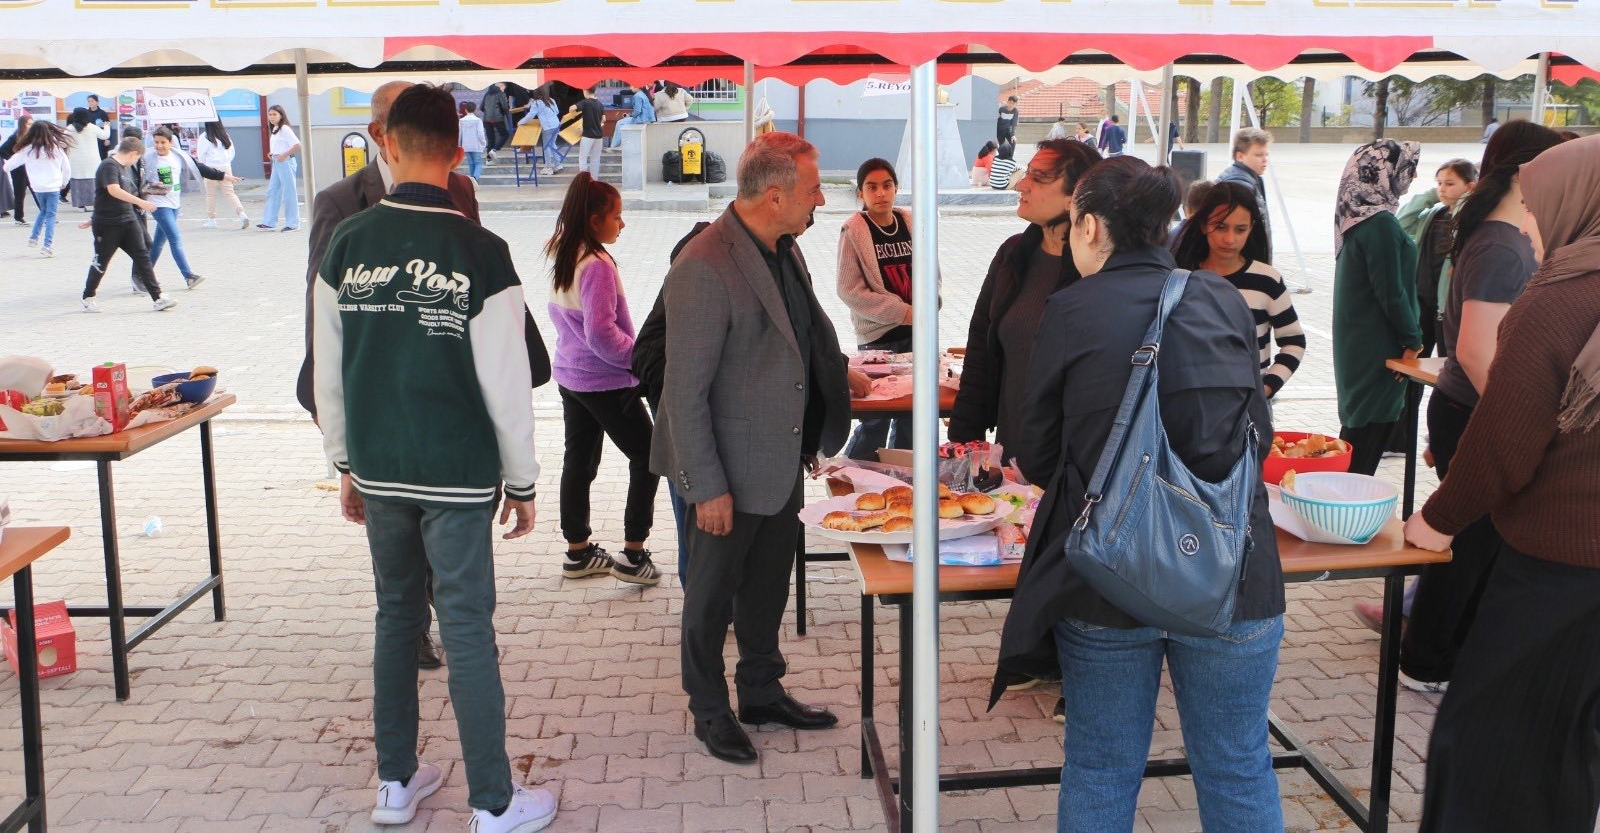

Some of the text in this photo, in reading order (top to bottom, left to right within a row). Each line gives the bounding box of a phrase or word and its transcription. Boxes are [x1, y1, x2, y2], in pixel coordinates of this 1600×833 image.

[867, 81, 912, 91] 5.REYO
[148, 98, 206, 108] 6.REYON
[337, 264, 399, 299] New
[388, 303, 405, 313] CLUB
[418, 306, 437, 314] SPORTS
